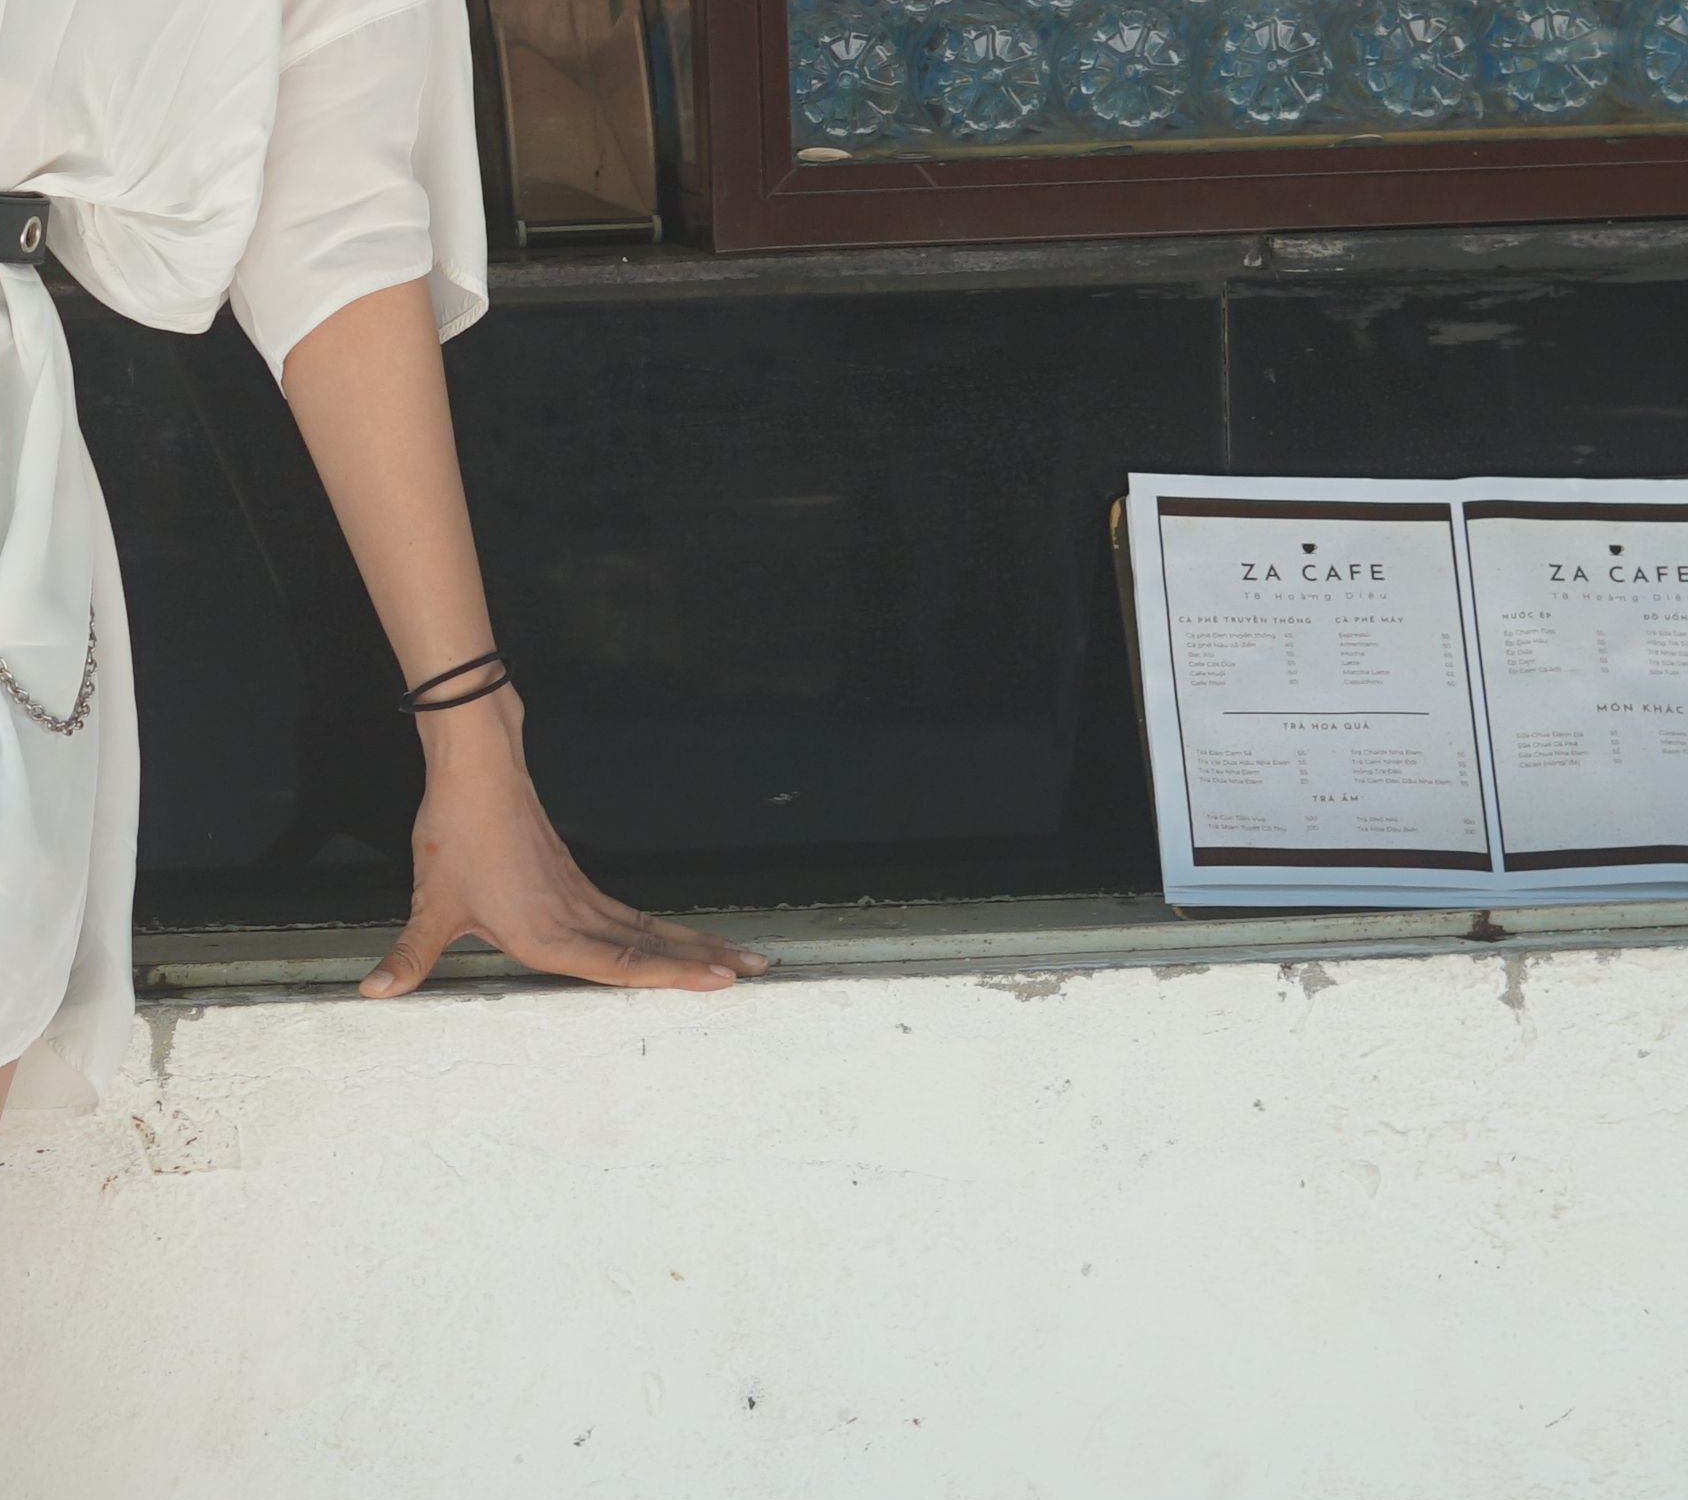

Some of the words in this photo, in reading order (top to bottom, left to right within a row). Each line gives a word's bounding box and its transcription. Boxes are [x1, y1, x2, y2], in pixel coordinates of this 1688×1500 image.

[1241, 563, 1282, 582] ZA
[1302, 563, 1387, 582] CAFE
[1548, 563, 1590, 582] ZA
[1608, 565, 1688, 584] CAFE
[1311, 722, 1337, 730] HOA
